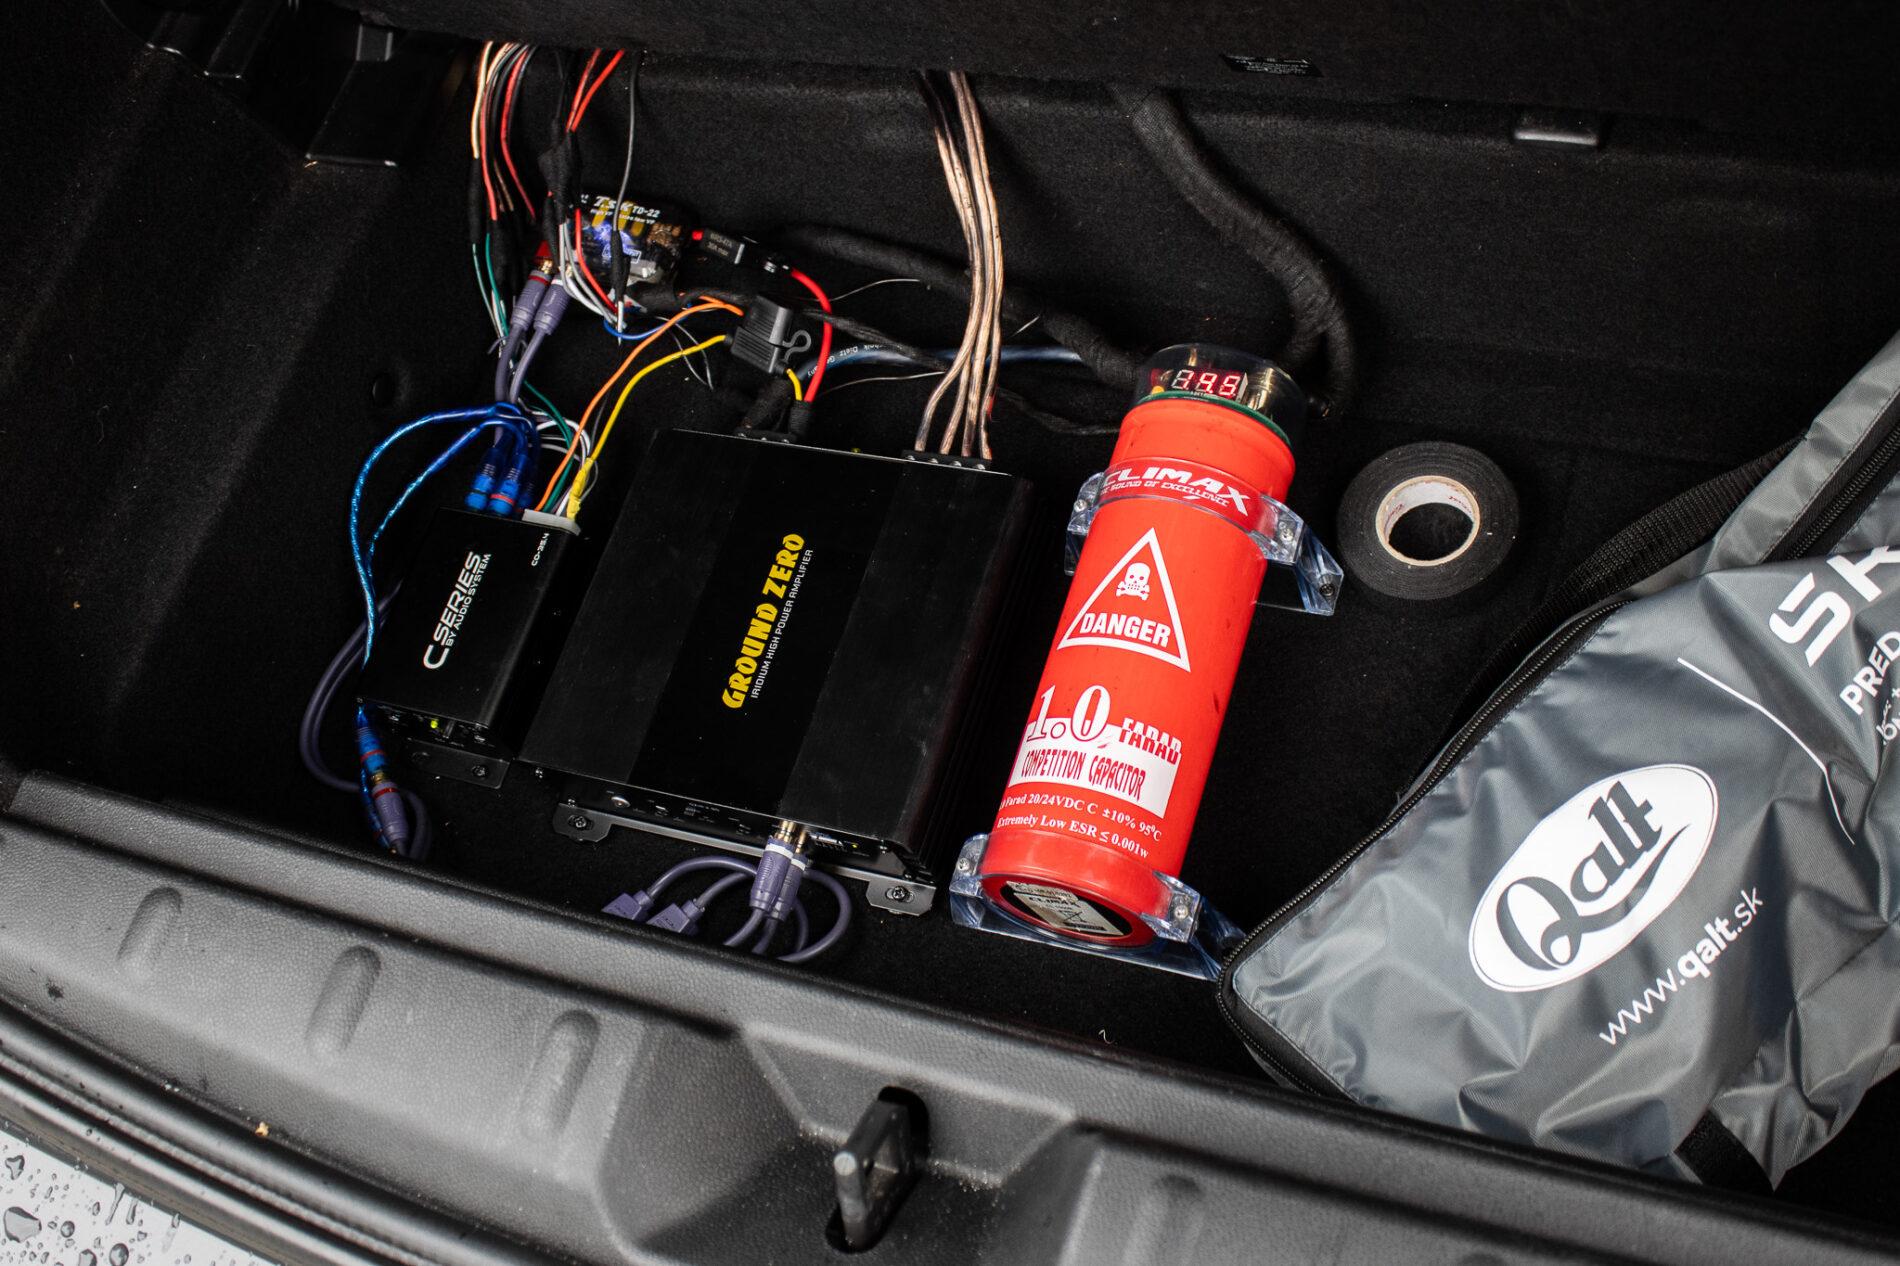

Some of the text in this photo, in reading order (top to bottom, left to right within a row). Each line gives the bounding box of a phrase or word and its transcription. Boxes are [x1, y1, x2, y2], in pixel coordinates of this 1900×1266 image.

[1103, 467, 1250, 517] CLIMAX
[433, 551, 481, 646] SERIES
[445, 553, 492, 647] BY AUDIO SYSTEM
[722, 533, 805, 708] GROUND ZERO
[750, 549, 814, 699] IRIDIUM HIGH POWER AMPLIFIER
[1079, 612, 1171, 648] DANGER
[1026, 684, 1183, 766] 1.0 FARAD
[1021, 749, 1147, 801] COMPETITION CAPACITOR
[1028, 793, 1085, 811] 20/24VDC
[997, 814, 1039, 828] Extremely
[1040, 815, 1067, 829] Low
[1069, 820, 1098, 837] ESR
[1496, 780, 1693, 970] Qalt
[1599, 887, 1764, 1045] www.qalt.sk
